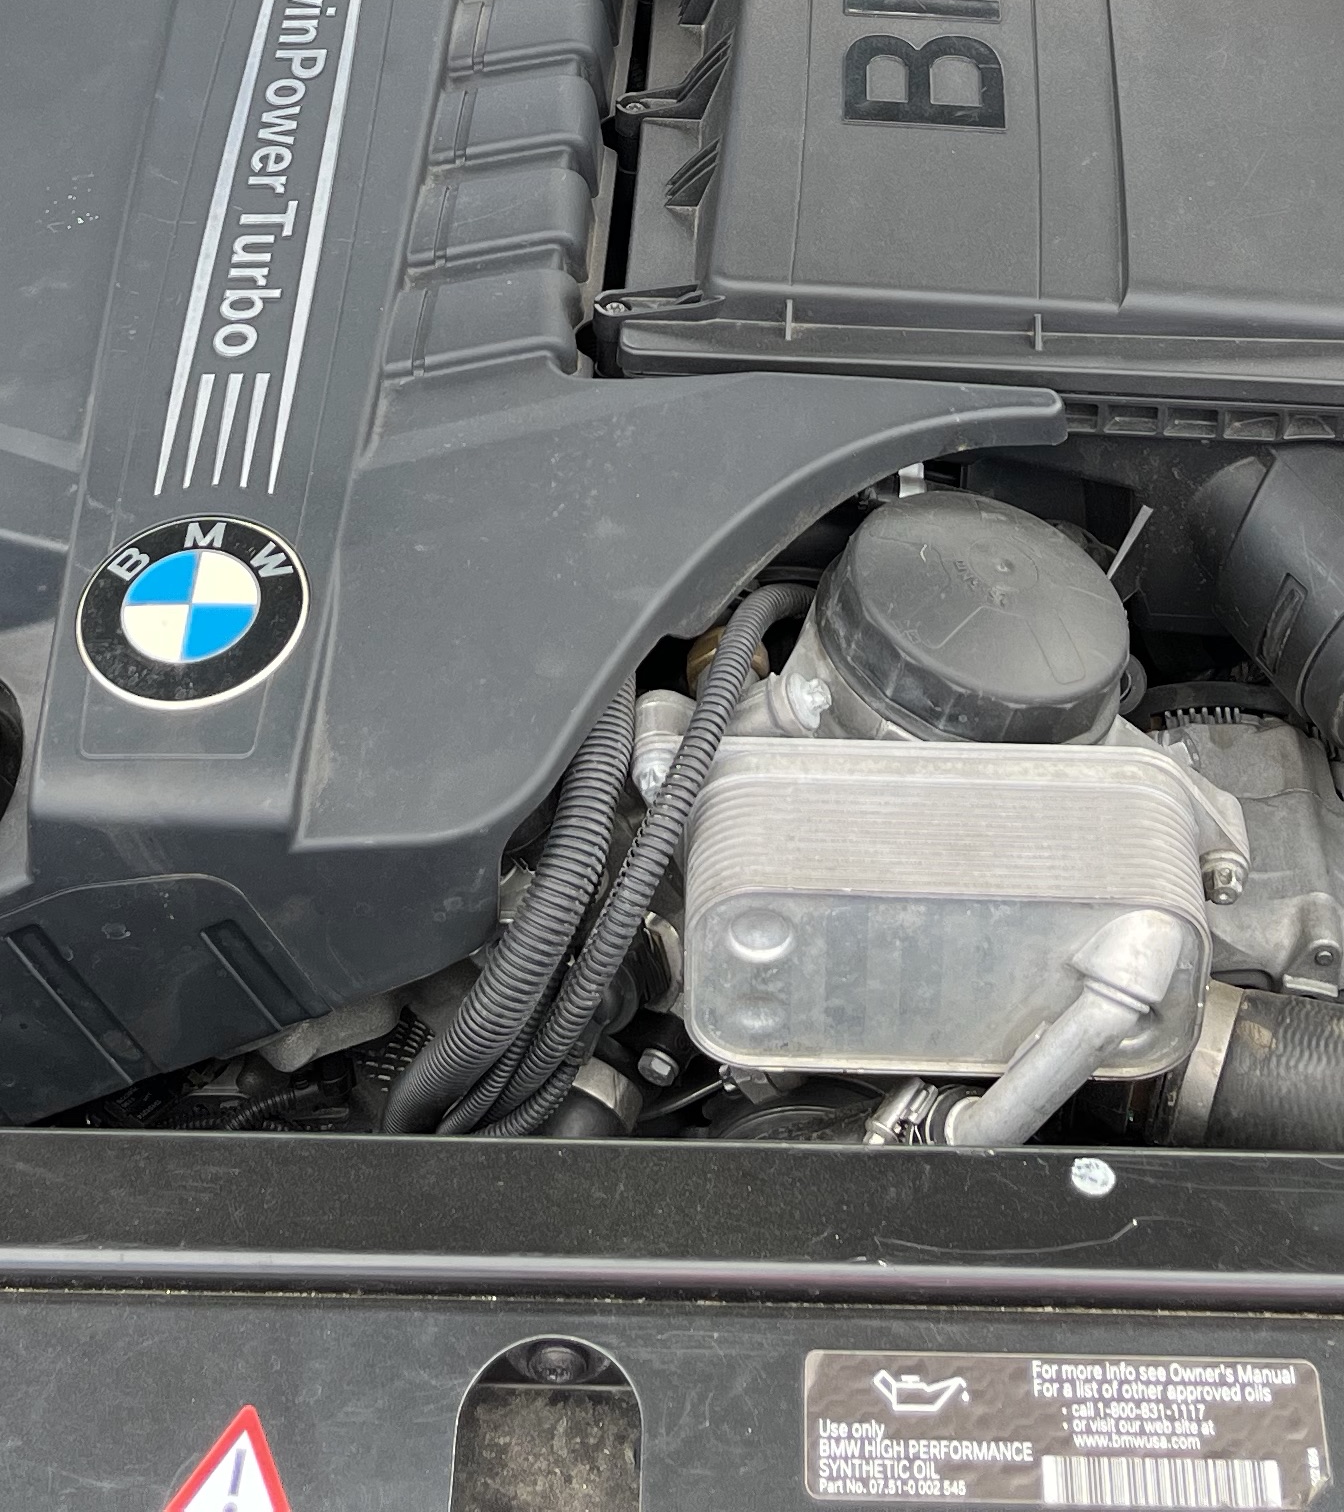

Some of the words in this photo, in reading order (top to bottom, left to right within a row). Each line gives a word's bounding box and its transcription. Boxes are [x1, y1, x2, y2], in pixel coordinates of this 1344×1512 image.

[212, 199, 299, 357] Turbo
[107, 521, 295, 582] BMW
[1032, 1360, 1058, 1380] For
[1061, 1364, 1102, 1381] more
[1106, 1361, 1135, 1382] info
[1139, 1366, 1166, 1381] see
[1169, 1362, 1234, 1383] Owner's
[1237, 1364, 1295, 1385] Manual
[1033, 1379, 1058, 1397] For
[1062, 1382, 1072, 1397] a
[1075, 1380, 1098, 1398] list
[1102, 1380, 1118, 1398] of
[1121, 1381, 1162, 1399] other
[1166, 1382, 1241, 1404] approved
[1244, 1383, 1271, 1402] oils
[1071, 1401, 1094, 1417] call
[1097, 1401, 1205, 1420] 1-800-831-1117
[819, 1419, 848, 1438] Use
[851, 1420, 885, 1440] only
[1072, 1418, 1086, 1435] or
[1089, 1418, 1116, 1436] visit
[1118, 1419, 1140, 1436] our
[1143, 1419, 1172, 1436] web
[1174, 1419, 1198, 1434] site
[1200, 1420, 1215, 1435] at
[819, 1439, 860, 1460] BMW
[864, 1440, 904, 1460] HIGH
[908, 1440, 1033, 1462] PERFORMANCE
[1073, 1433, 1200, 1449] www.bmwusa.com
[818, 1459, 910, 1480] SYNTHETIC
[913, 1460, 940, 1480] OIL
